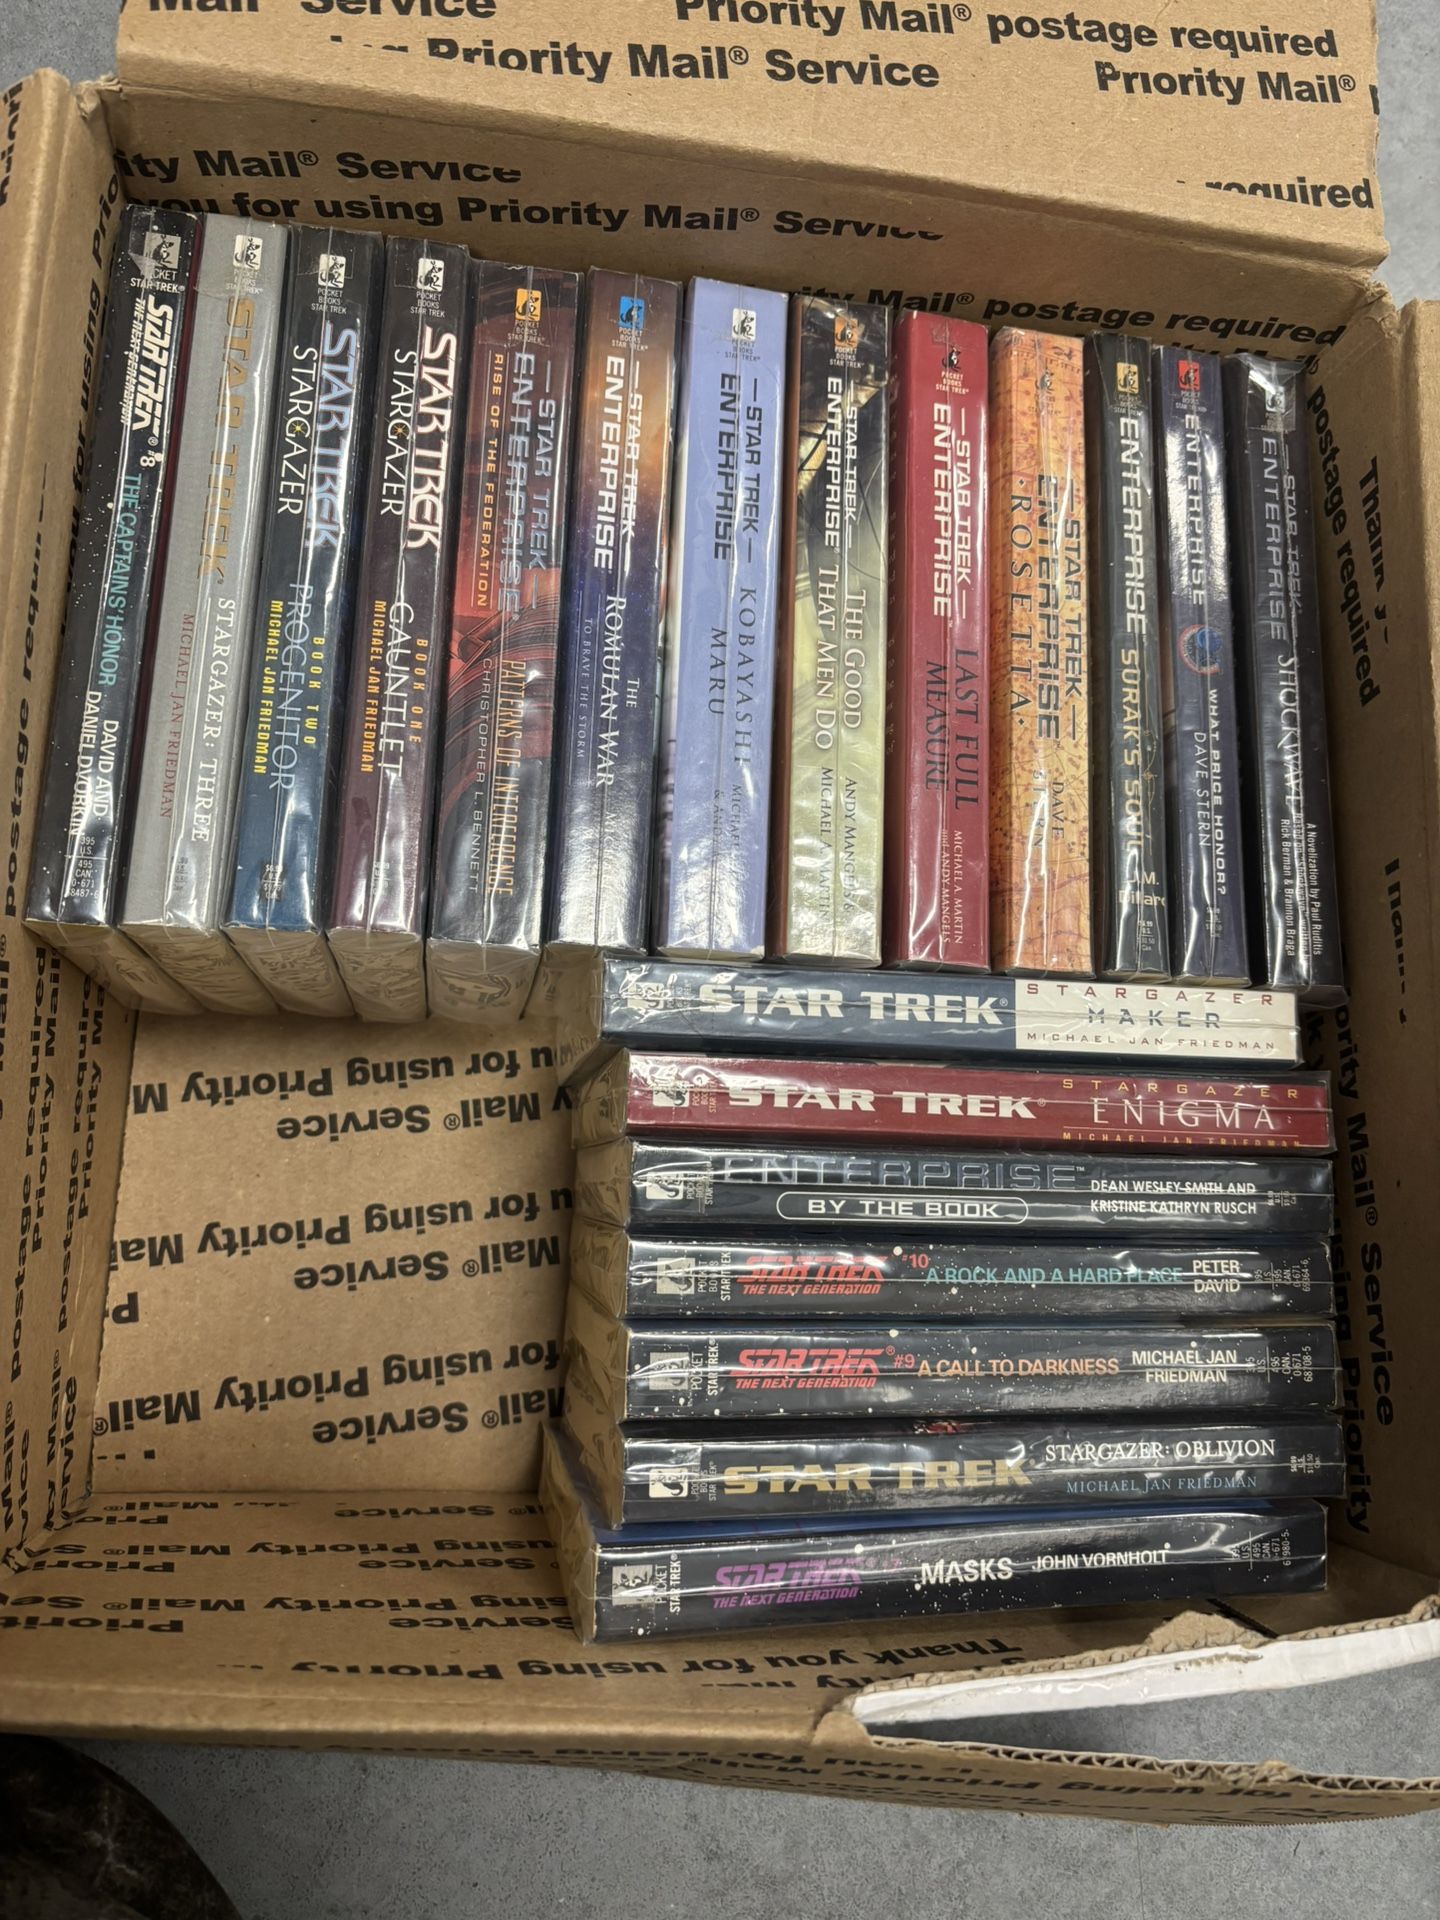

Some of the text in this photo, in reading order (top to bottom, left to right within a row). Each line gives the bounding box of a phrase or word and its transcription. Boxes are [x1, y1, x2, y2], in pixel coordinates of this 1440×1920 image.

[765, 49, 940, 88] Service
[987, 13, 1157, 53] postage
[1170, 26, 1339, 58] required
[1095, 61, 1245, 105] Priority
[313, 195, 629, 232] using Priority
[983, 300, 1349, 347] postage required
[278, 345, 318, 514] STARGAZER
[381, 348, 417, 515] STARGAZER
[407, 324, 457, 549] STAR TREK
[486, 353, 503, 473] RISE OF THE
[120, 474, 142, 508] THE
[528, 399, 556, 570] STAR TREK
[593, 356, 625, 570] ENTERPRISE
[714, 373, 740, 560] ENTERPRISE
[742, 406, 762, 533] STAR TREK
[844, 406, 857, 521] STAR TREK
[934, 403, 951, 616] ENTERPRISE
[1119, 418, 1147, 634] ENTERPRISE
[1184, 414, 1206, 606] ENTERPRISE
[1262, 437, 1286, 641] ENTERPRISE
[957, 516, 971, 584] TREK
[1065, 520, 1081, 599] STAR
[1307, 385, 1380, 707] postage required
[1010, 495, 1033, 710] ROSETTA
[98, 615, 124, 686] HONOR
[598, 595, 627, 720] ROMULAN
[708, 628, 727, 715] MARU
[734, 587, 757, 764] KOBAYASHI
[160, 613, 194, 818] MICHAEL JAN FRIEDMAN
[191, 598, 235, 842] STARGAZER: THREE
[254, 600, 283, 774] MICHAEL JAN FRIEDMAN
[271, 583, 314, 790] PROGENITOR
[304, 637, 325, 744] BOOK TWO
[361, 601, 386, 772] MICHAEL JAN FRIEDMAN
[377, 602, 414, 776] GAUNTLET
[409, 639, 428, 743] BOOK ONE
[576, 640, 592, 758] BRAVE THE STORM
[626, 678, 640, 708] THE
[815, 640, 837, 749] MEN DO
[843, 650, 864, 728] GOOD
[1121, 650, 1142, 765] SURAK'S
[595, 731, 619, 787] WAR
[925, 660, 950, 791] MEASURE
[955, 650, 979, 810] LAST FULL
[69, 691, 101, 835] DANIEL DVORKIN
[93, 720, 119, 817] DAVID AND
[485, 660, 527, 895] PATTERNS INTERFERENCE
[1209, 689, 1226, 895] WHAT PRICE HONOR?
[820, 767, 833, 836] MICHAEL
[1051, 781, 1065, 839] DAVE
[1197, 789, 1211, 847] STERN
[953, 831, 963, 944] MICHAEL MARTIN
[1281, 841, 1292, 875] Berman
[1284, 888, 1295, 927] Brannon
[1307, 831, 1323, 955] Novelization Paul Ruditis
[699, 980, 843, 1019] STAR
[1027, 983, 1273, 1006] STARGAZER
[1088, 1007, 1220, 1029] MAKER
[1027, 1032, 1275, 1050] MICHAEL JAN FRIEDMAN
[181, 1050, 520, 1105] for using Priority
[728, 1085, 874, 1112] STAR
[1063, 1079, 1298, 1099] STARGAZER
[277, 1104, 431, 1141] Service
[1093, 1097, 1275, 1130] ENIGMA
[807, 1200, 999, 1218] BY THE BOOK
[1091, 1180, 1256, 1195] DEAN WESLEY SMITH AND
[1091, 1200, 1257, 1215] KRISTINE KATHRYN RUSCH
[58, 1150, 82, 1333] postage
[198, 1192, 539, 1257] for using Priority
[11, 1174, 32, 1383] postage
[294, 1250, 449, 1290] Service
[799, 1283, 881, 1295] GENERATION
[1004, 1268, 1046, 1284] AND
[1193, 1260, 1240, 1275] PETER
[1194, 1279, 1240, 1293] DAVID
[894, 1353, 915, 1369] #9
[1018, 1358, 1120, 1376] DARKNESS
[1132, 1350, 1237, 1364] MICHAEL JAN
[1359, 1243, 1394, 1426] Service
[214, 1340, 560, 1413] for using Priority
[797, 1376, 877, 1388] GENERATION
[1145, 1368, 1227, 1383] FRIEDMAN
[312, 1402, 468, 1444] Service
[1045, 1438, 1276, 1462] STARGAZER: OBLIVION
[1340, 1357, 1373, 1534] Priority
[723, 1461, 873, 1494] STAR
[1067, 1475, 1258, 1493] MICHAEL JAN FRIEDMAN
[334, 1505, 495, 1519] Service
[358, 1557, 535, 1570] Service
[920, 1558, 1013, 1585] MASKS
[1032, 1550, 1169, 1570] JOHN VORNHOLT
[263, 1597, 456, 1612] Priority
[517, 1638, 1022, 1678] Thank you for using
